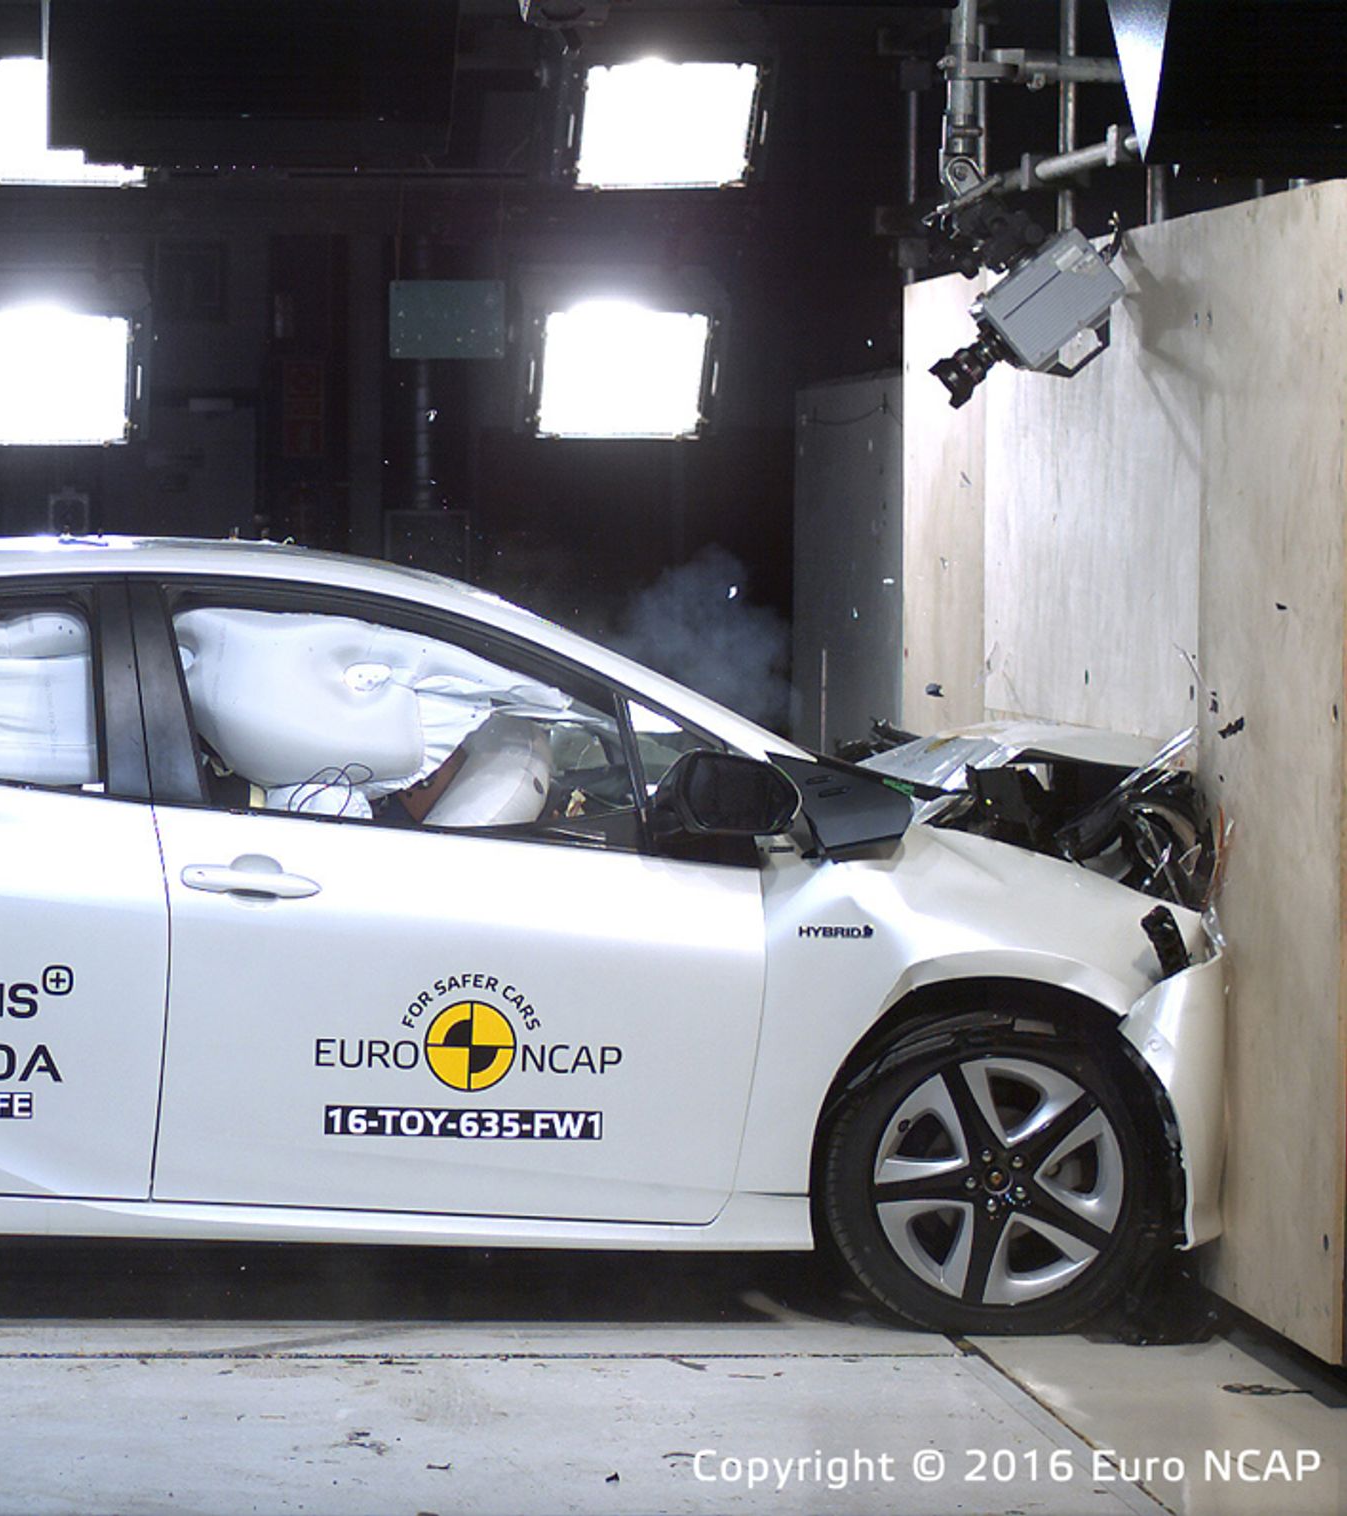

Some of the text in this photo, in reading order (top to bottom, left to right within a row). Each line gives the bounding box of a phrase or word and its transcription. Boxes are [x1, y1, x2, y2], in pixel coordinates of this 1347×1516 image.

[798, 926, 861, 939] HYBRID
[401, 973, 541, 1031] FOR SAFER CARS
[314, 1038, 623, 1074] EURO NCAP
[327, 1108, 602, 1139] 16-TOY-635-FW1
